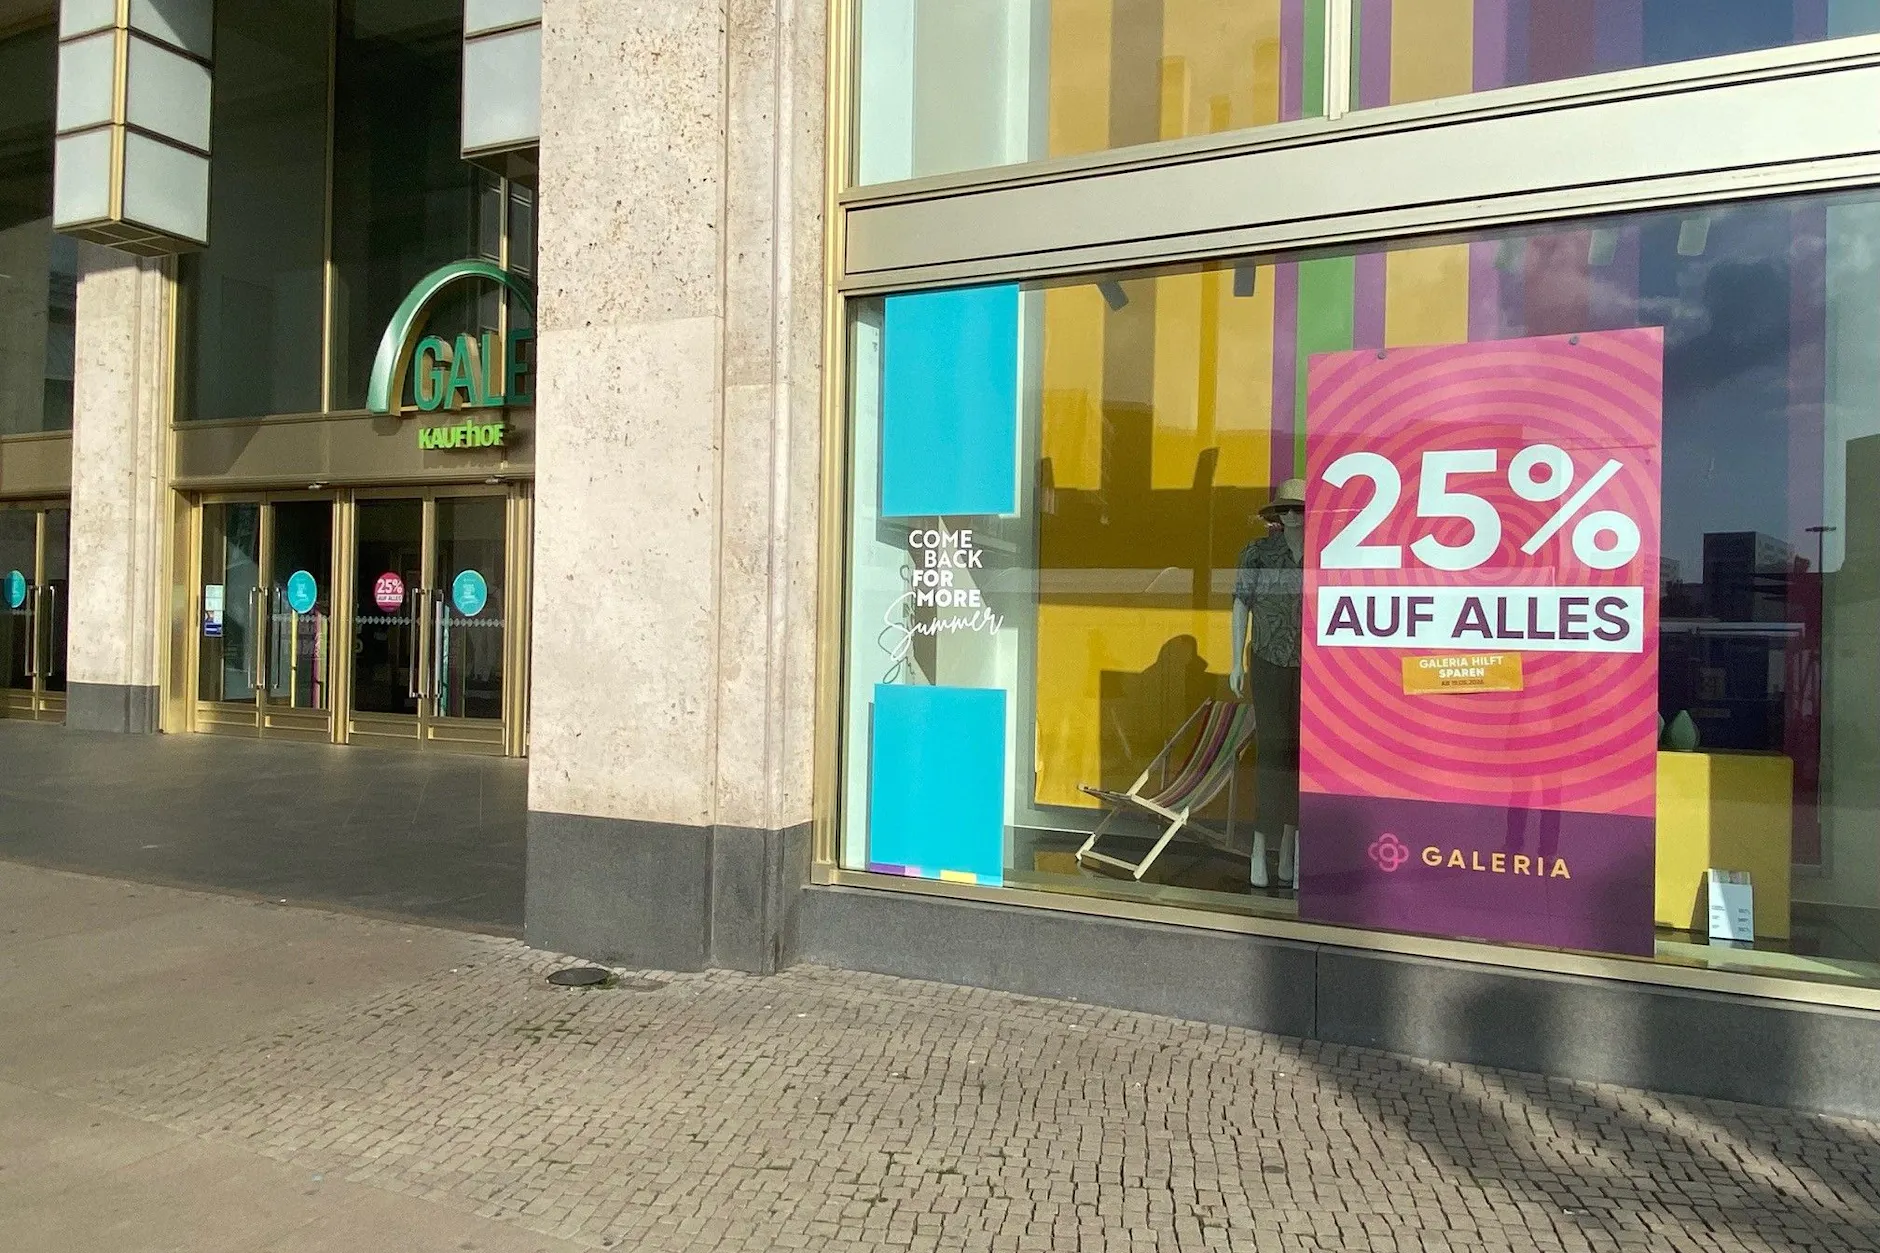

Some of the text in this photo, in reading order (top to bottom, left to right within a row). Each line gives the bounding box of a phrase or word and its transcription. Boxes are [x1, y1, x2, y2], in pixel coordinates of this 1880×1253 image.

[414, 330, 534, 411] GALE
[1320, 443, 1641, 571] 25%
[908, 529, 973, 549] COME
[924, 550, 983, 569] BACK
[377, 578, 402, 593] 25%
[912, 569, 954, 587] FOR
[915, 589, 981, 608] MORE
[884, 591, 1004, 661] Summer
[1325, 596, 1630, 642] AUF ALLES
[1419, 655, 1504, 669] GALERIA HILFT
[1438, 667, 1485, 679] SPAREN
[1421, 846, 1571, 879] GALERIA
